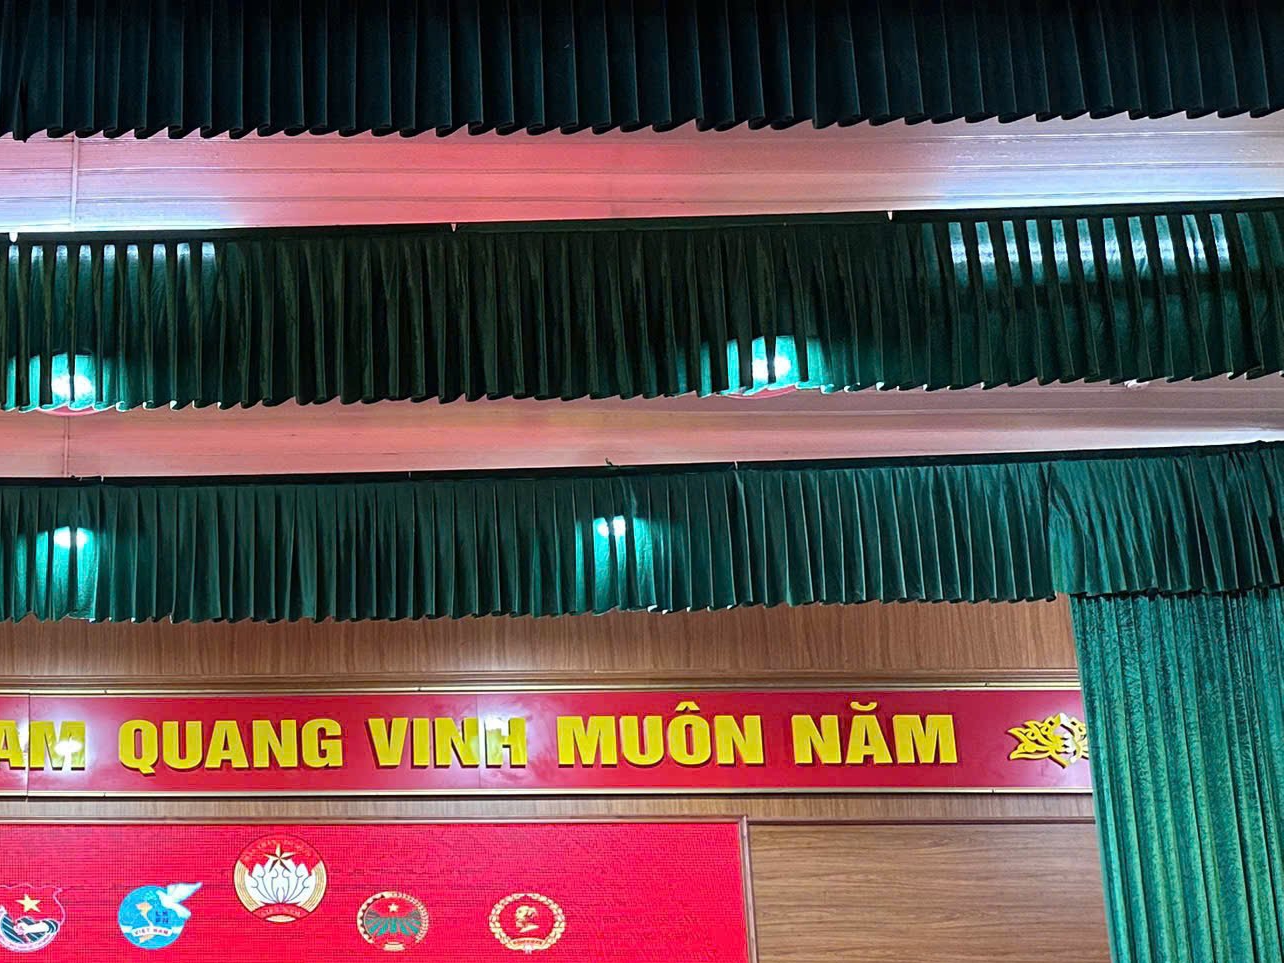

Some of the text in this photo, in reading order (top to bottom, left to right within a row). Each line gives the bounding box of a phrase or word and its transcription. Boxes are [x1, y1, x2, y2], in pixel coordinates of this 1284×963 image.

[118, 718, 343, 775] QUANG
[367, 716, 528, 766] VINH
[556, 701, 764, 766] MUÔN
[791, 701, 958, 764] NĂM
